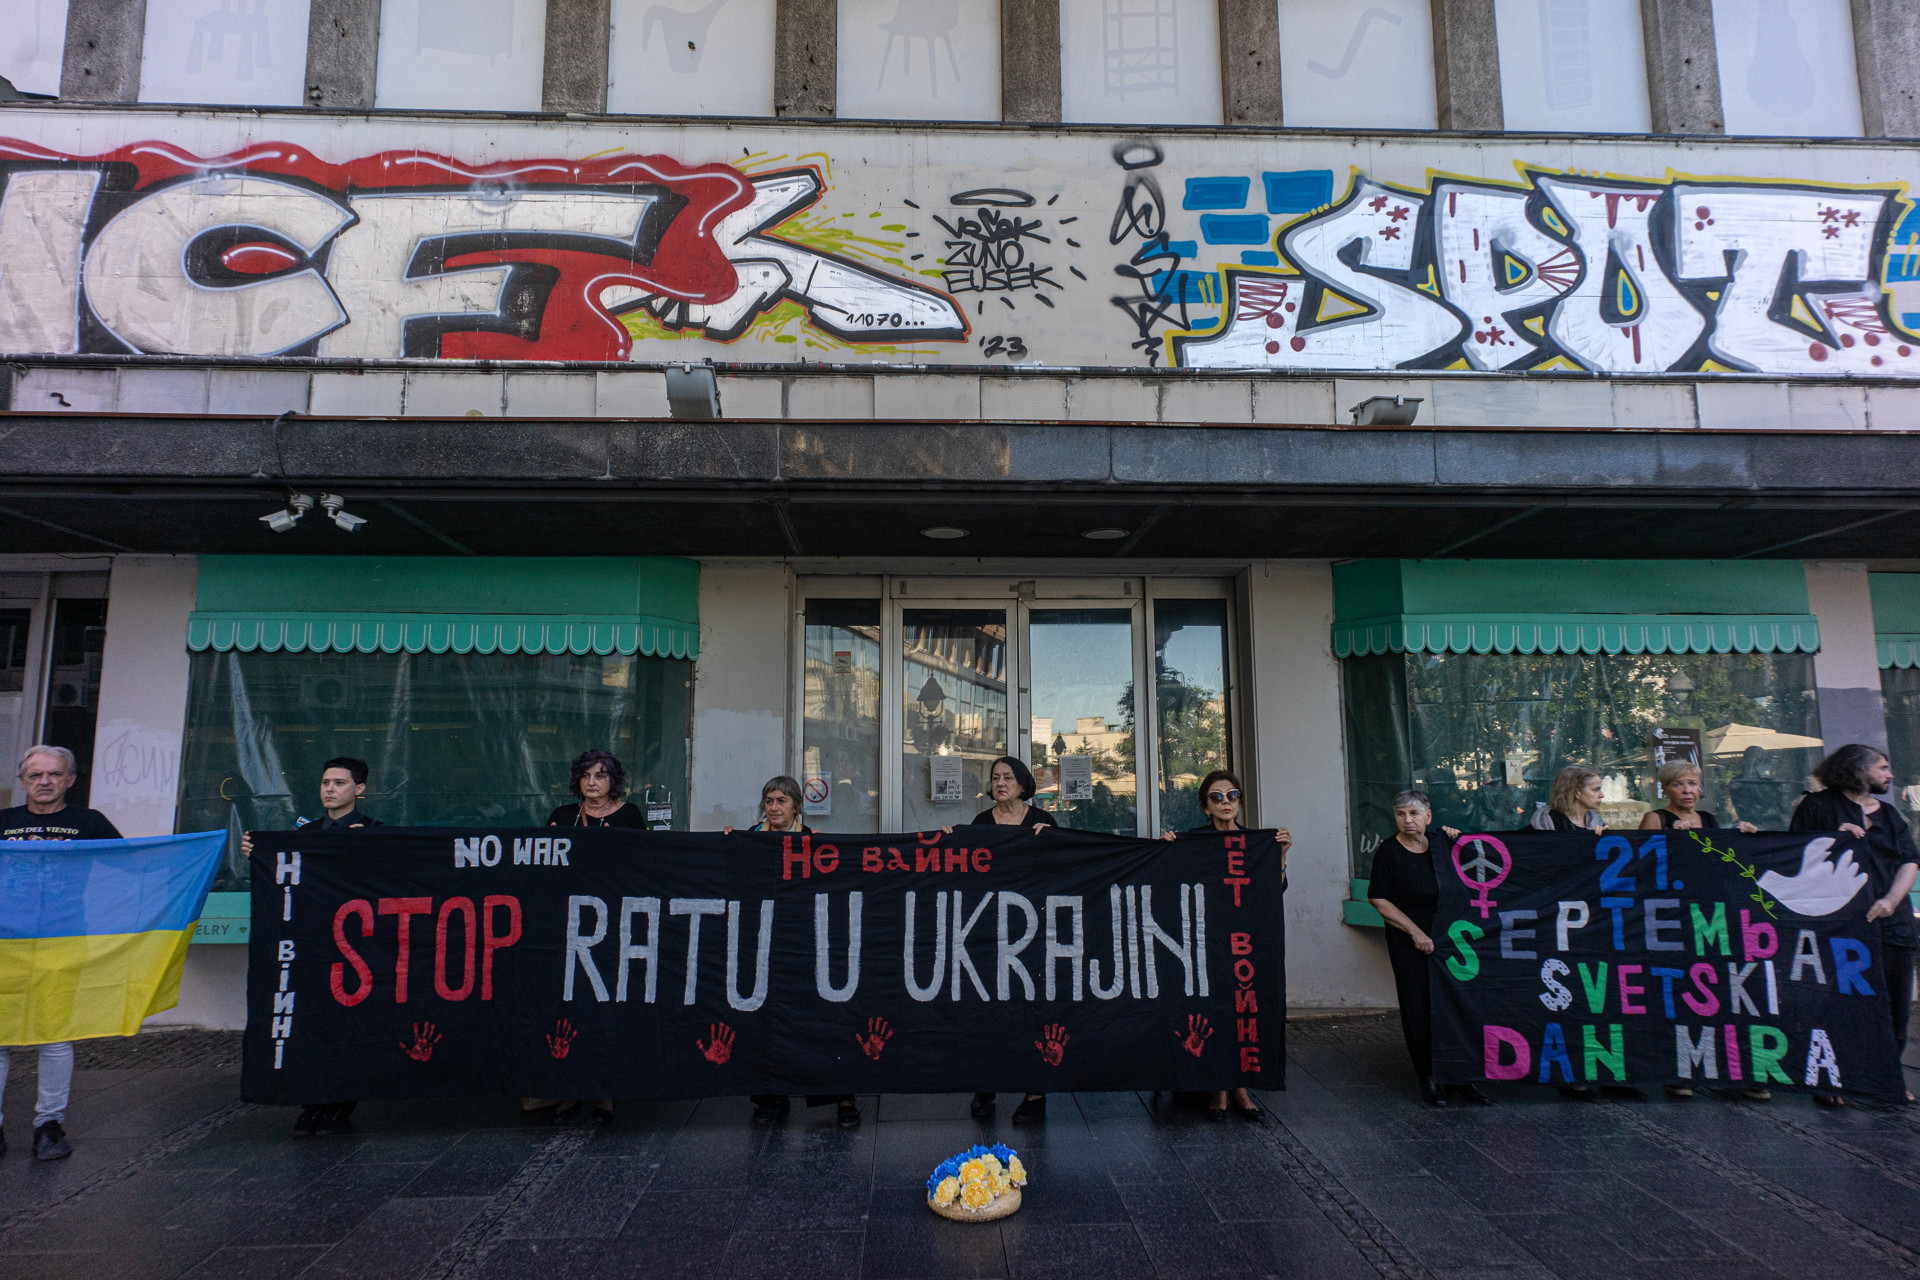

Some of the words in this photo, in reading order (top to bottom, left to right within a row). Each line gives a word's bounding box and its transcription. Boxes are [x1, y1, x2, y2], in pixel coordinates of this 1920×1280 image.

[3, 827, 25, 836] DIOS
[45, 826, 79, 835] VIENTO
[454, 835, 502, 868] NO
[514, 838, 572, 866] WAR
[782, 835, 840, 880] Не
[1223, 834, 1251, 908] НЕТ
[1595, 834, 1685, 893] 21.
[329, 894, 523, 1008] STOP
[563, 894, 775, 1012] RATU
[814, 890, 863, 1003] U
[903, 882, 1210, 1003] UKRAJINI
[1230, 932, 1261, 1073] ВОЙНЕ
[1539, 958, 1780, 1019] SVETSKI
[1483, 1022, 1627, 1083] DAN
[1675, 1024, 1843, 1088] MIRA
